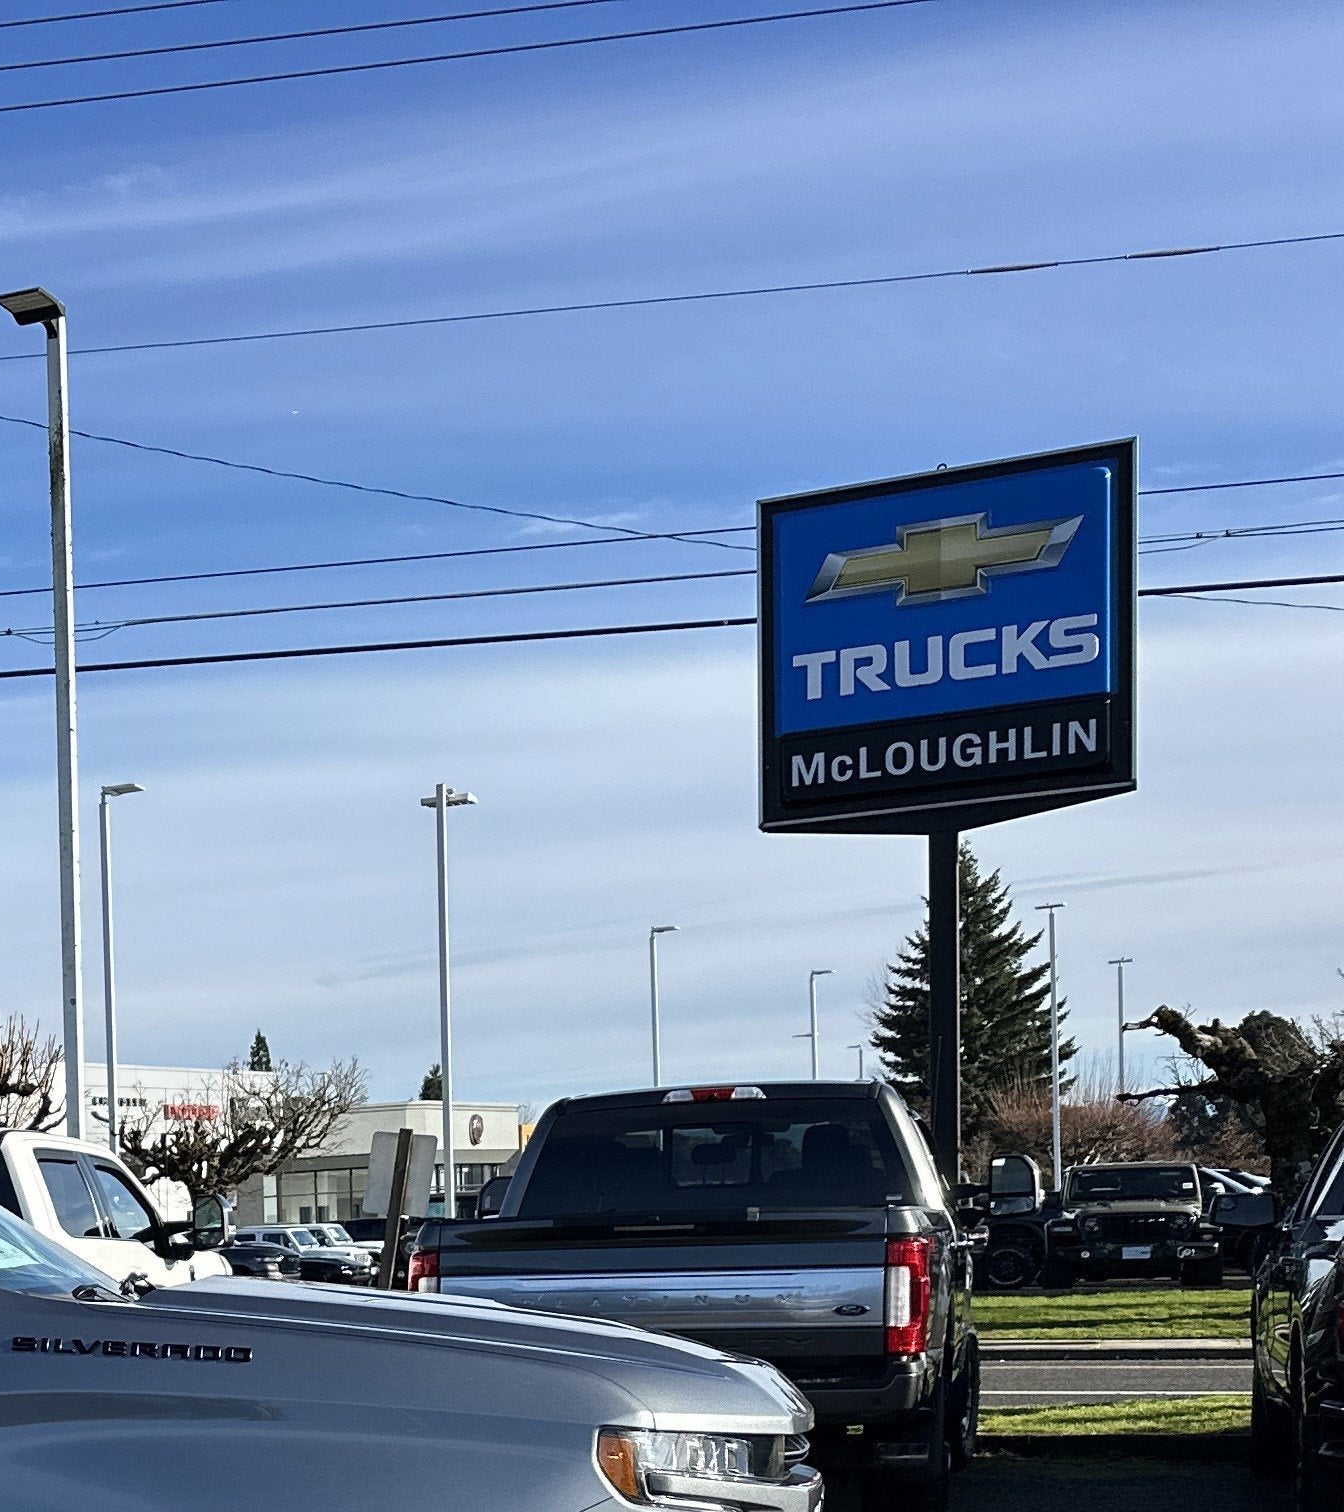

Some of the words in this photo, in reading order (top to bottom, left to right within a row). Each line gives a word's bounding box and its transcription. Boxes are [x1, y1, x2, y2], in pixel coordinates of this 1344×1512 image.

[792, 612, 1100, 701] TRUCKS
[790, 717, 1098, 788] McLOUGHLIN
[11, 1335, 254, 1363] SILVERADO
